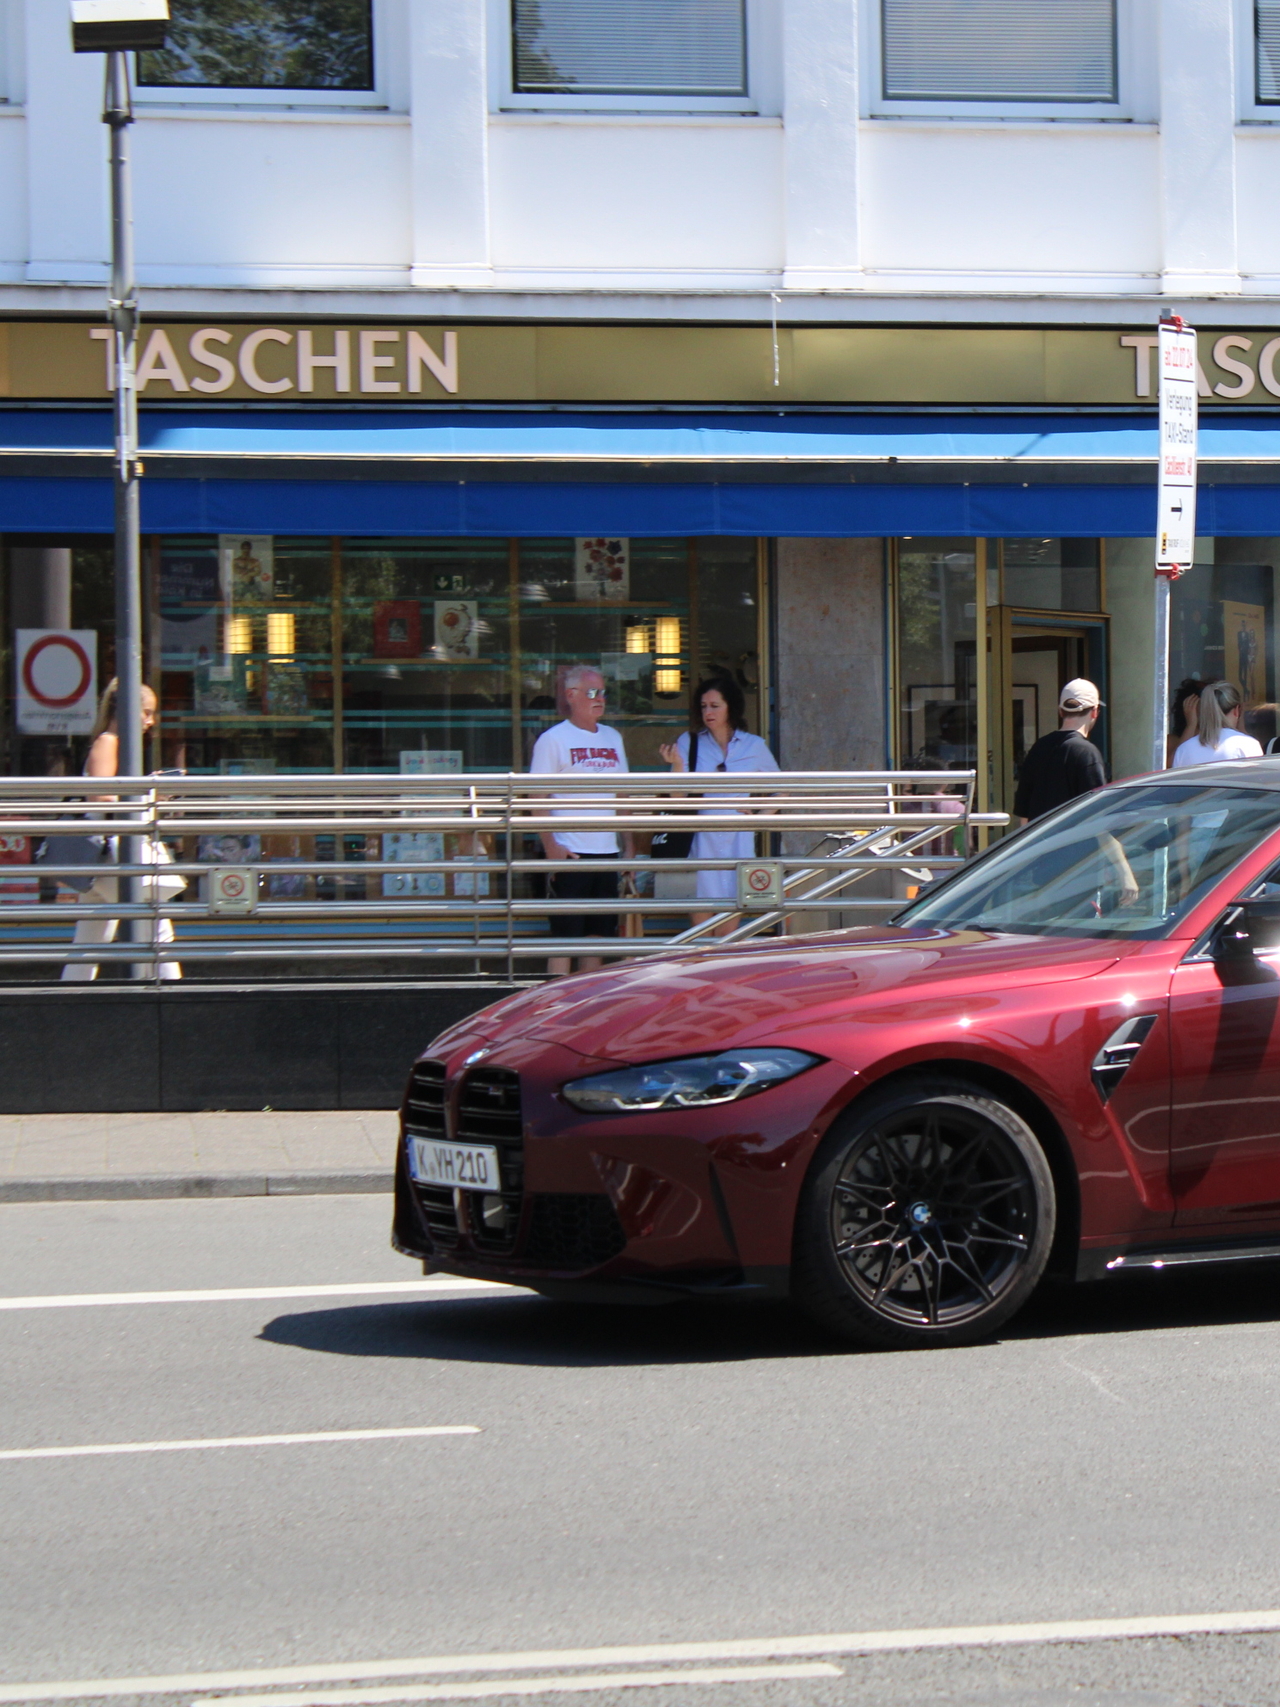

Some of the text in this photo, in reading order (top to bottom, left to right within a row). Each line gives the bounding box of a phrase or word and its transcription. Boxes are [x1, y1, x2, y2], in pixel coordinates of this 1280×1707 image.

[89, 328, 459, 394] TASCHEN
[1165, 420, 1194, 444] TAXI-Stand
[417, 1144, 487, 1184] K YH 210
